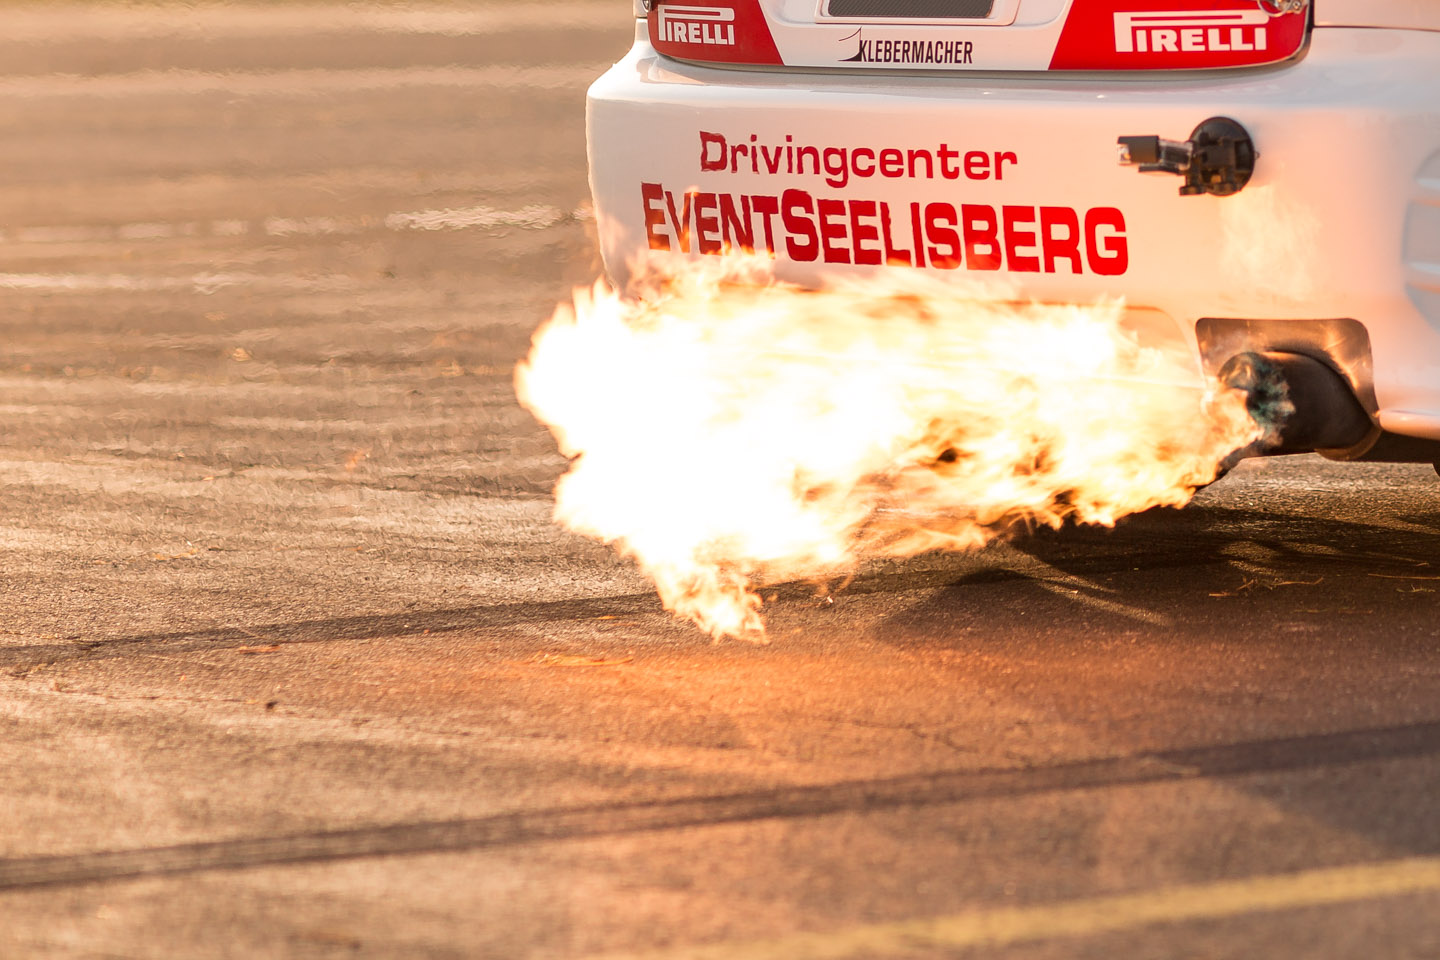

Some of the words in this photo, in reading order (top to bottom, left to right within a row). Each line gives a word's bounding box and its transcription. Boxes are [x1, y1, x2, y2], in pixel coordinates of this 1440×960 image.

[658, 4, 735, 46] PIRELLI
[1113, 9, 1270, 52] PIRELLI
[859, 39, 973, 64] KLEBERMACHER
[699, 131, 1018, 188] Drivingcenter
